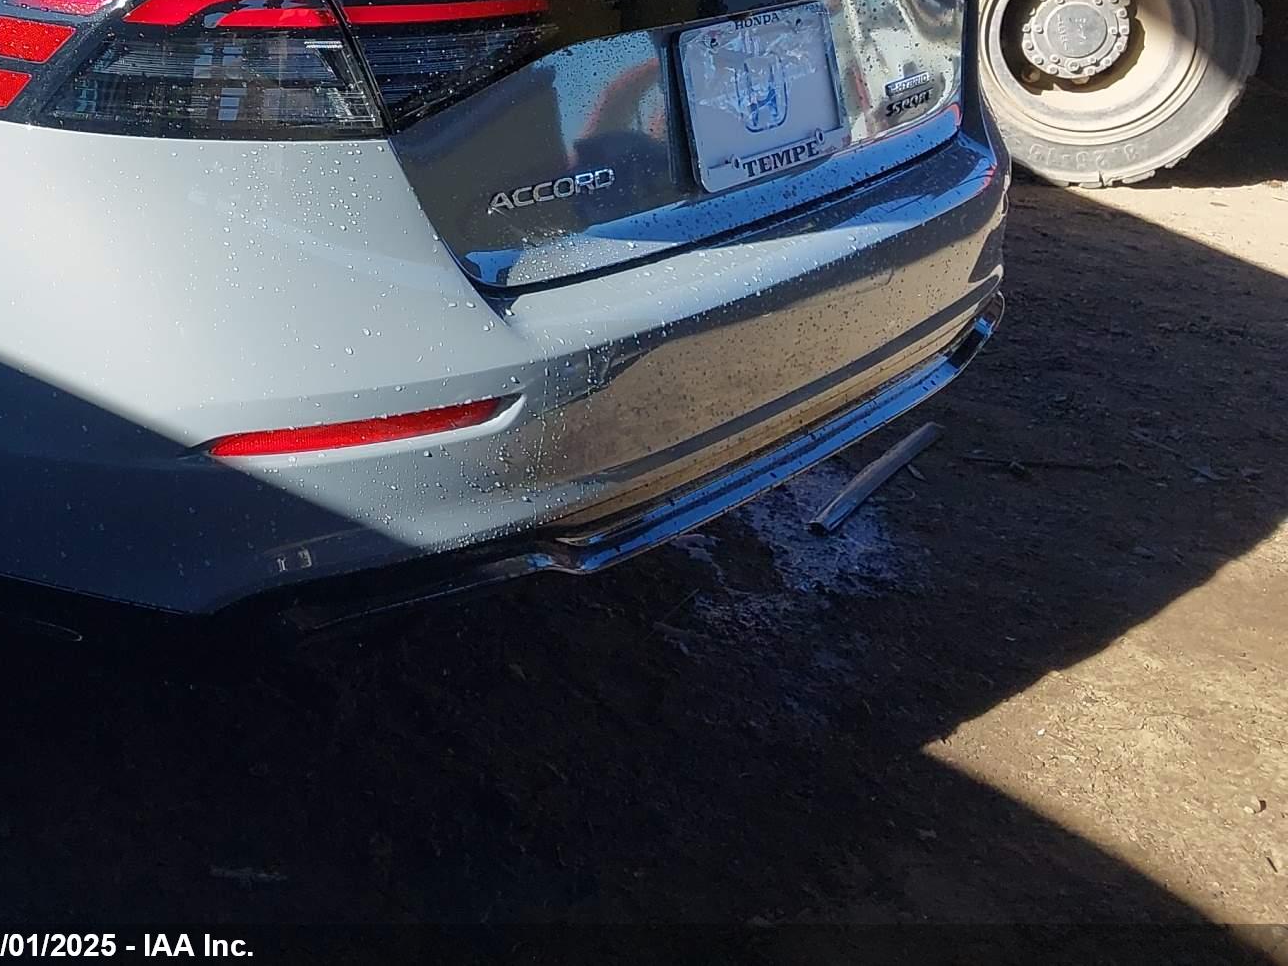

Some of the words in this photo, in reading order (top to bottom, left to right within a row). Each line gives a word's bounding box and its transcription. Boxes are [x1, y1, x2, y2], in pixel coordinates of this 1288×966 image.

[734, 12, 780, 30] HONDA
[742, 140, 820, 177] TEMPE
[489, 168, 615, 213] ACCORD
